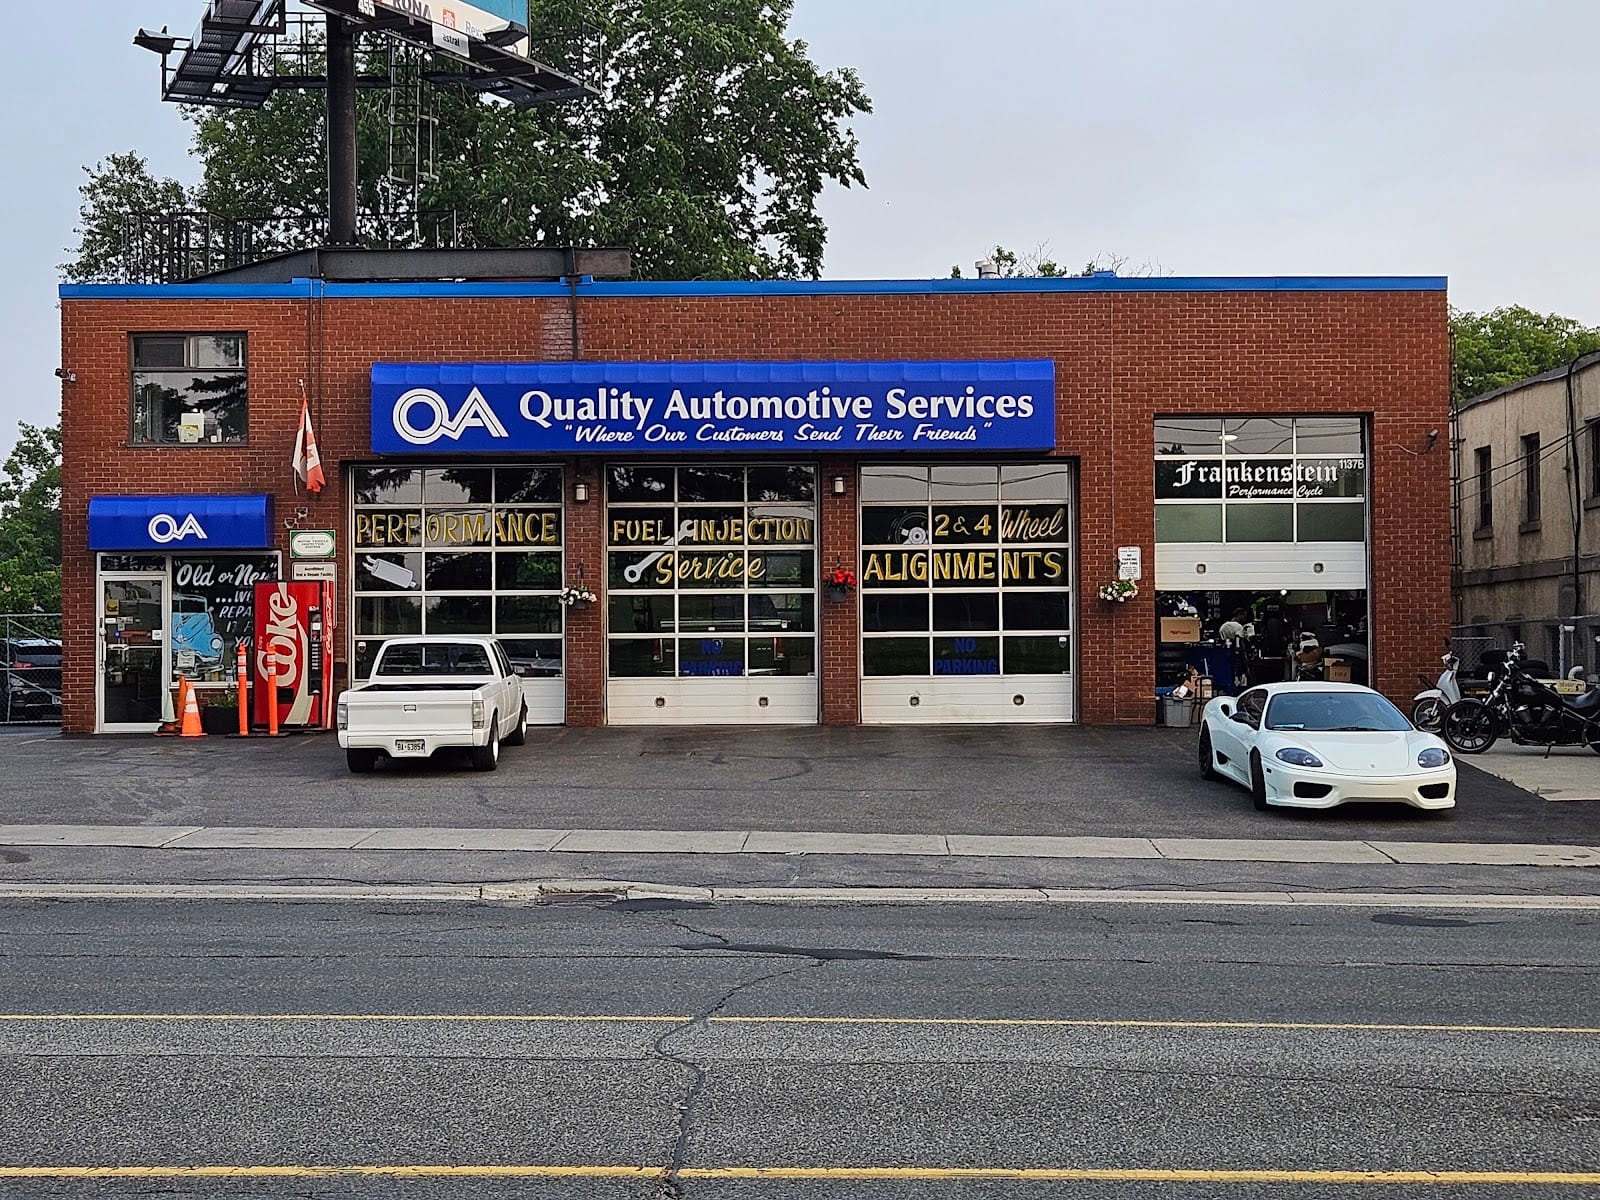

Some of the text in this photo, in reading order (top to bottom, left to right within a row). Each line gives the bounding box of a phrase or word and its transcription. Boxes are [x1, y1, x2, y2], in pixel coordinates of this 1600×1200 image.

[442, 33, 460, 47] astral
[519, 386, 1034, 430] Quality Automotive Services
[565, 421, 992, 443] "Where Our Customers Send Their Friends"
[1173, 461, 1338, 488] Frankenstein
[1338, 458, 1365, 470] 1137B
[1229, 484, 1323, 497] Performance Cycle
[356, 512, 558, 544] PERFORMANCE
[613, 517, 811, 543] FUEL INJECTION
[935, 508, 1065, 541] 2 & 4 Wheel
[217, 571, 234, 584] or
[655, 552, 766, 585] Service
[863, 551, 1062, 581] ALIGNMENTS
[257, 592, 297, 686] Coke
[954, 637, 977, 654] NO
[934, 658, 998, 675] PARKING
